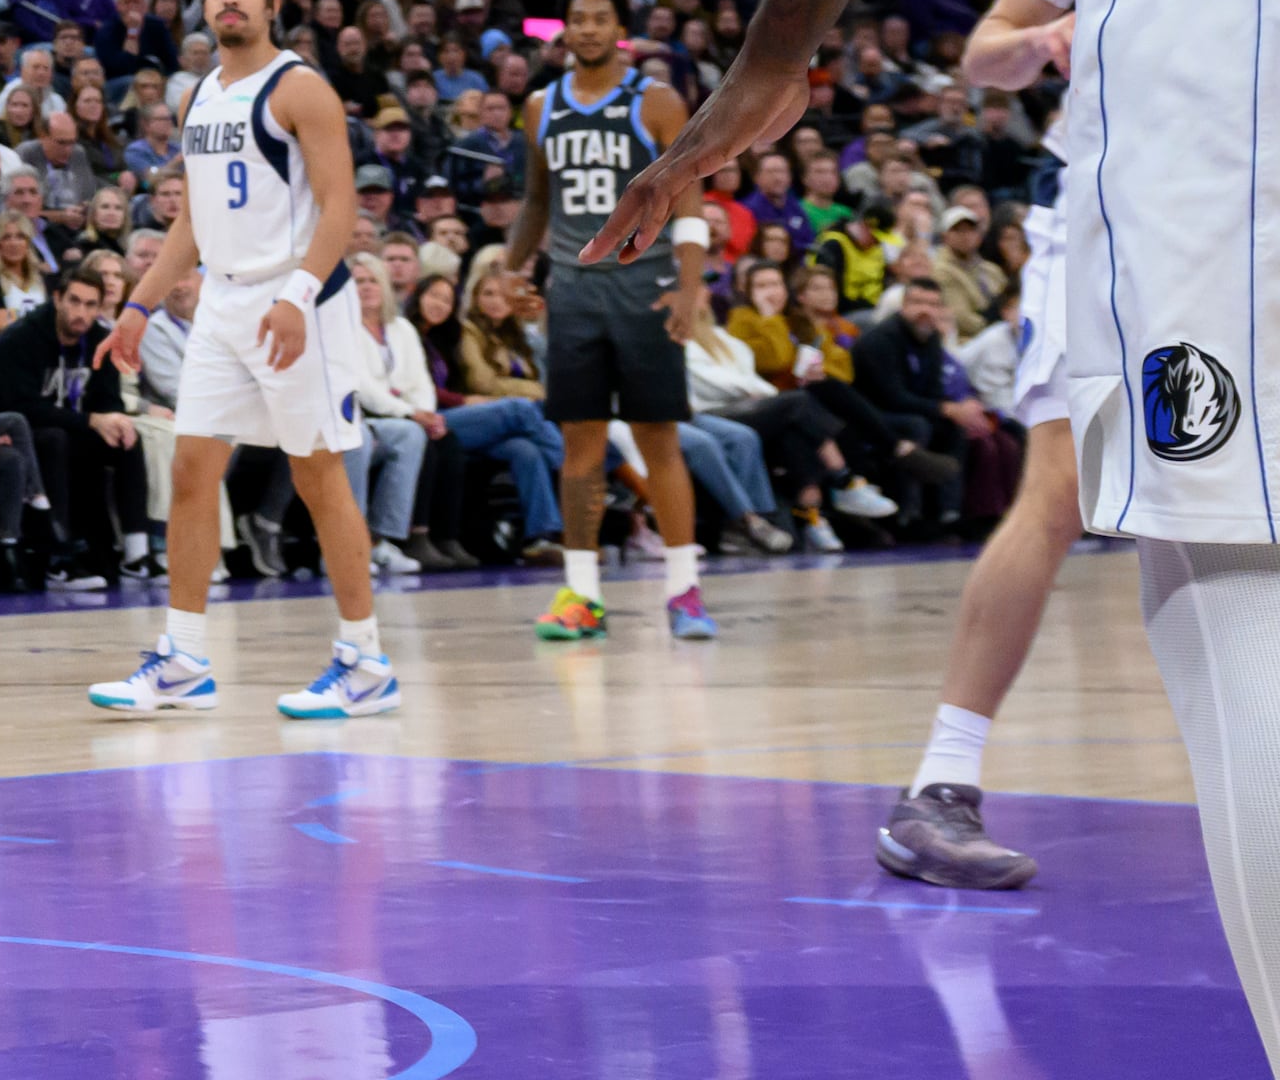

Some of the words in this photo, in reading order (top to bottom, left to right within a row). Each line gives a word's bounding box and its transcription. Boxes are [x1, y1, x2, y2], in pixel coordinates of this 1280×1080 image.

[545, 128, 631, 172] UTAH
[226, 160, 249, 210] 9
[561, 168, 617, 216] 28
